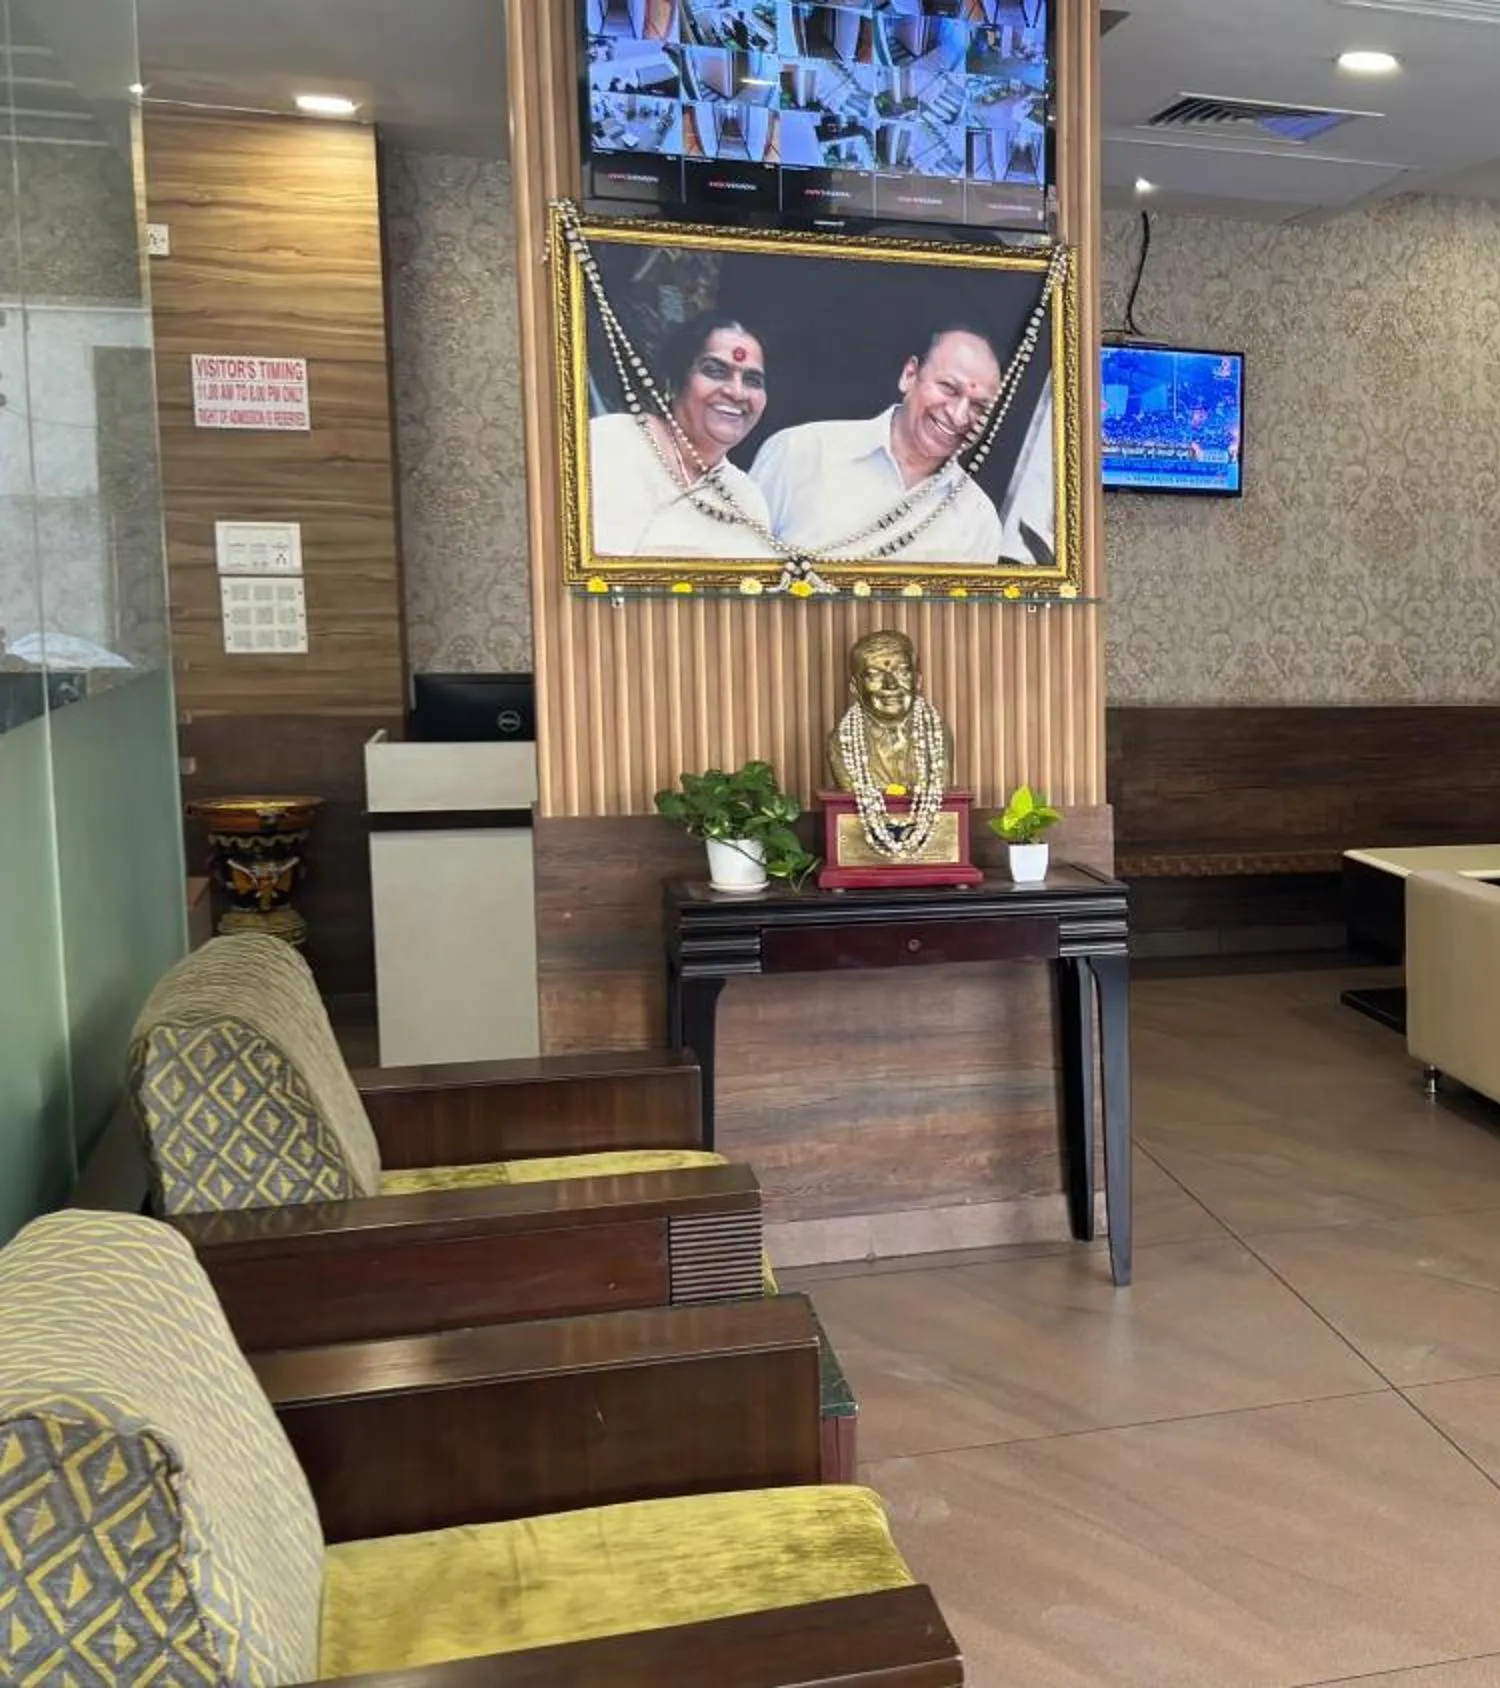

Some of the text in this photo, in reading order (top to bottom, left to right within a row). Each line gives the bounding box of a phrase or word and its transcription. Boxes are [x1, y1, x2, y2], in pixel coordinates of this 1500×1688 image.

[258, 361, 304, 381] TIMING
[221, 384, 234, 401] AM
[268, 385, 280, 402] PM
